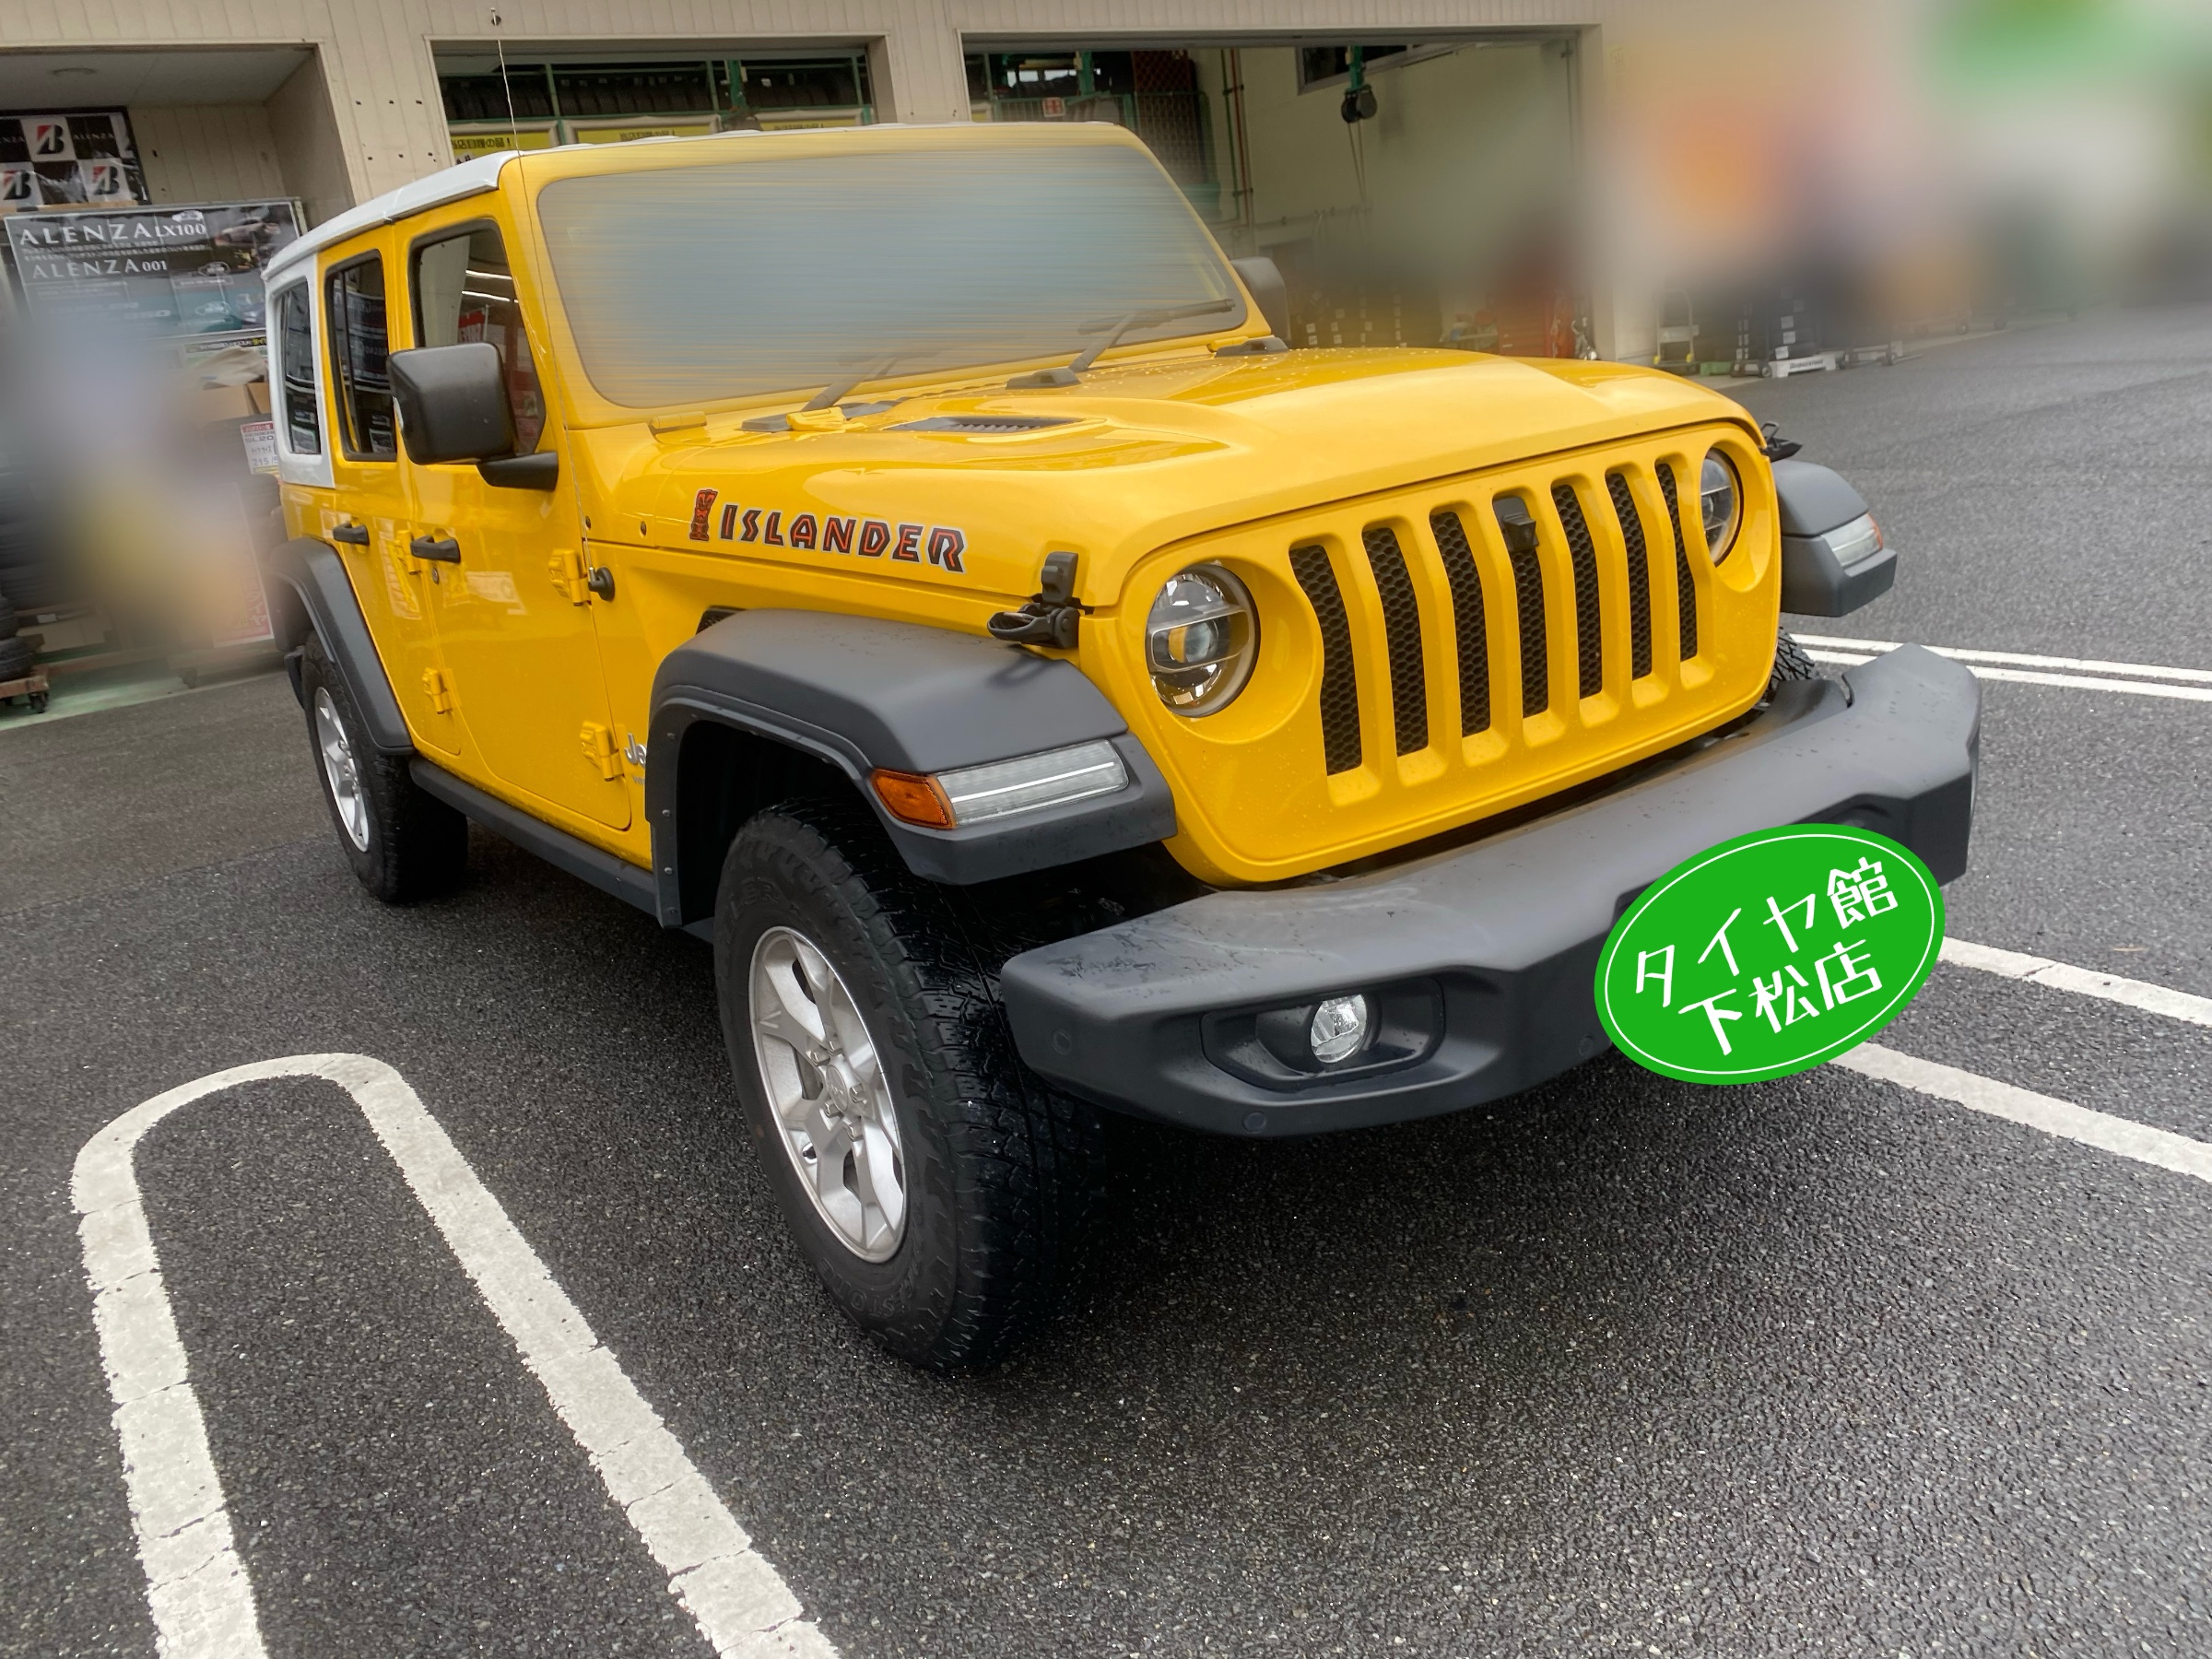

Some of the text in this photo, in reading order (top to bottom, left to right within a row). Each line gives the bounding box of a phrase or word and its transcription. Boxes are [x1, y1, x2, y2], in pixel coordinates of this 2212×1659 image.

[19, 222, 155, 245] ALENZA
[32, 258, 168, 279] ALENZA 001
[720, 503, 966, 573] ISLANDER
